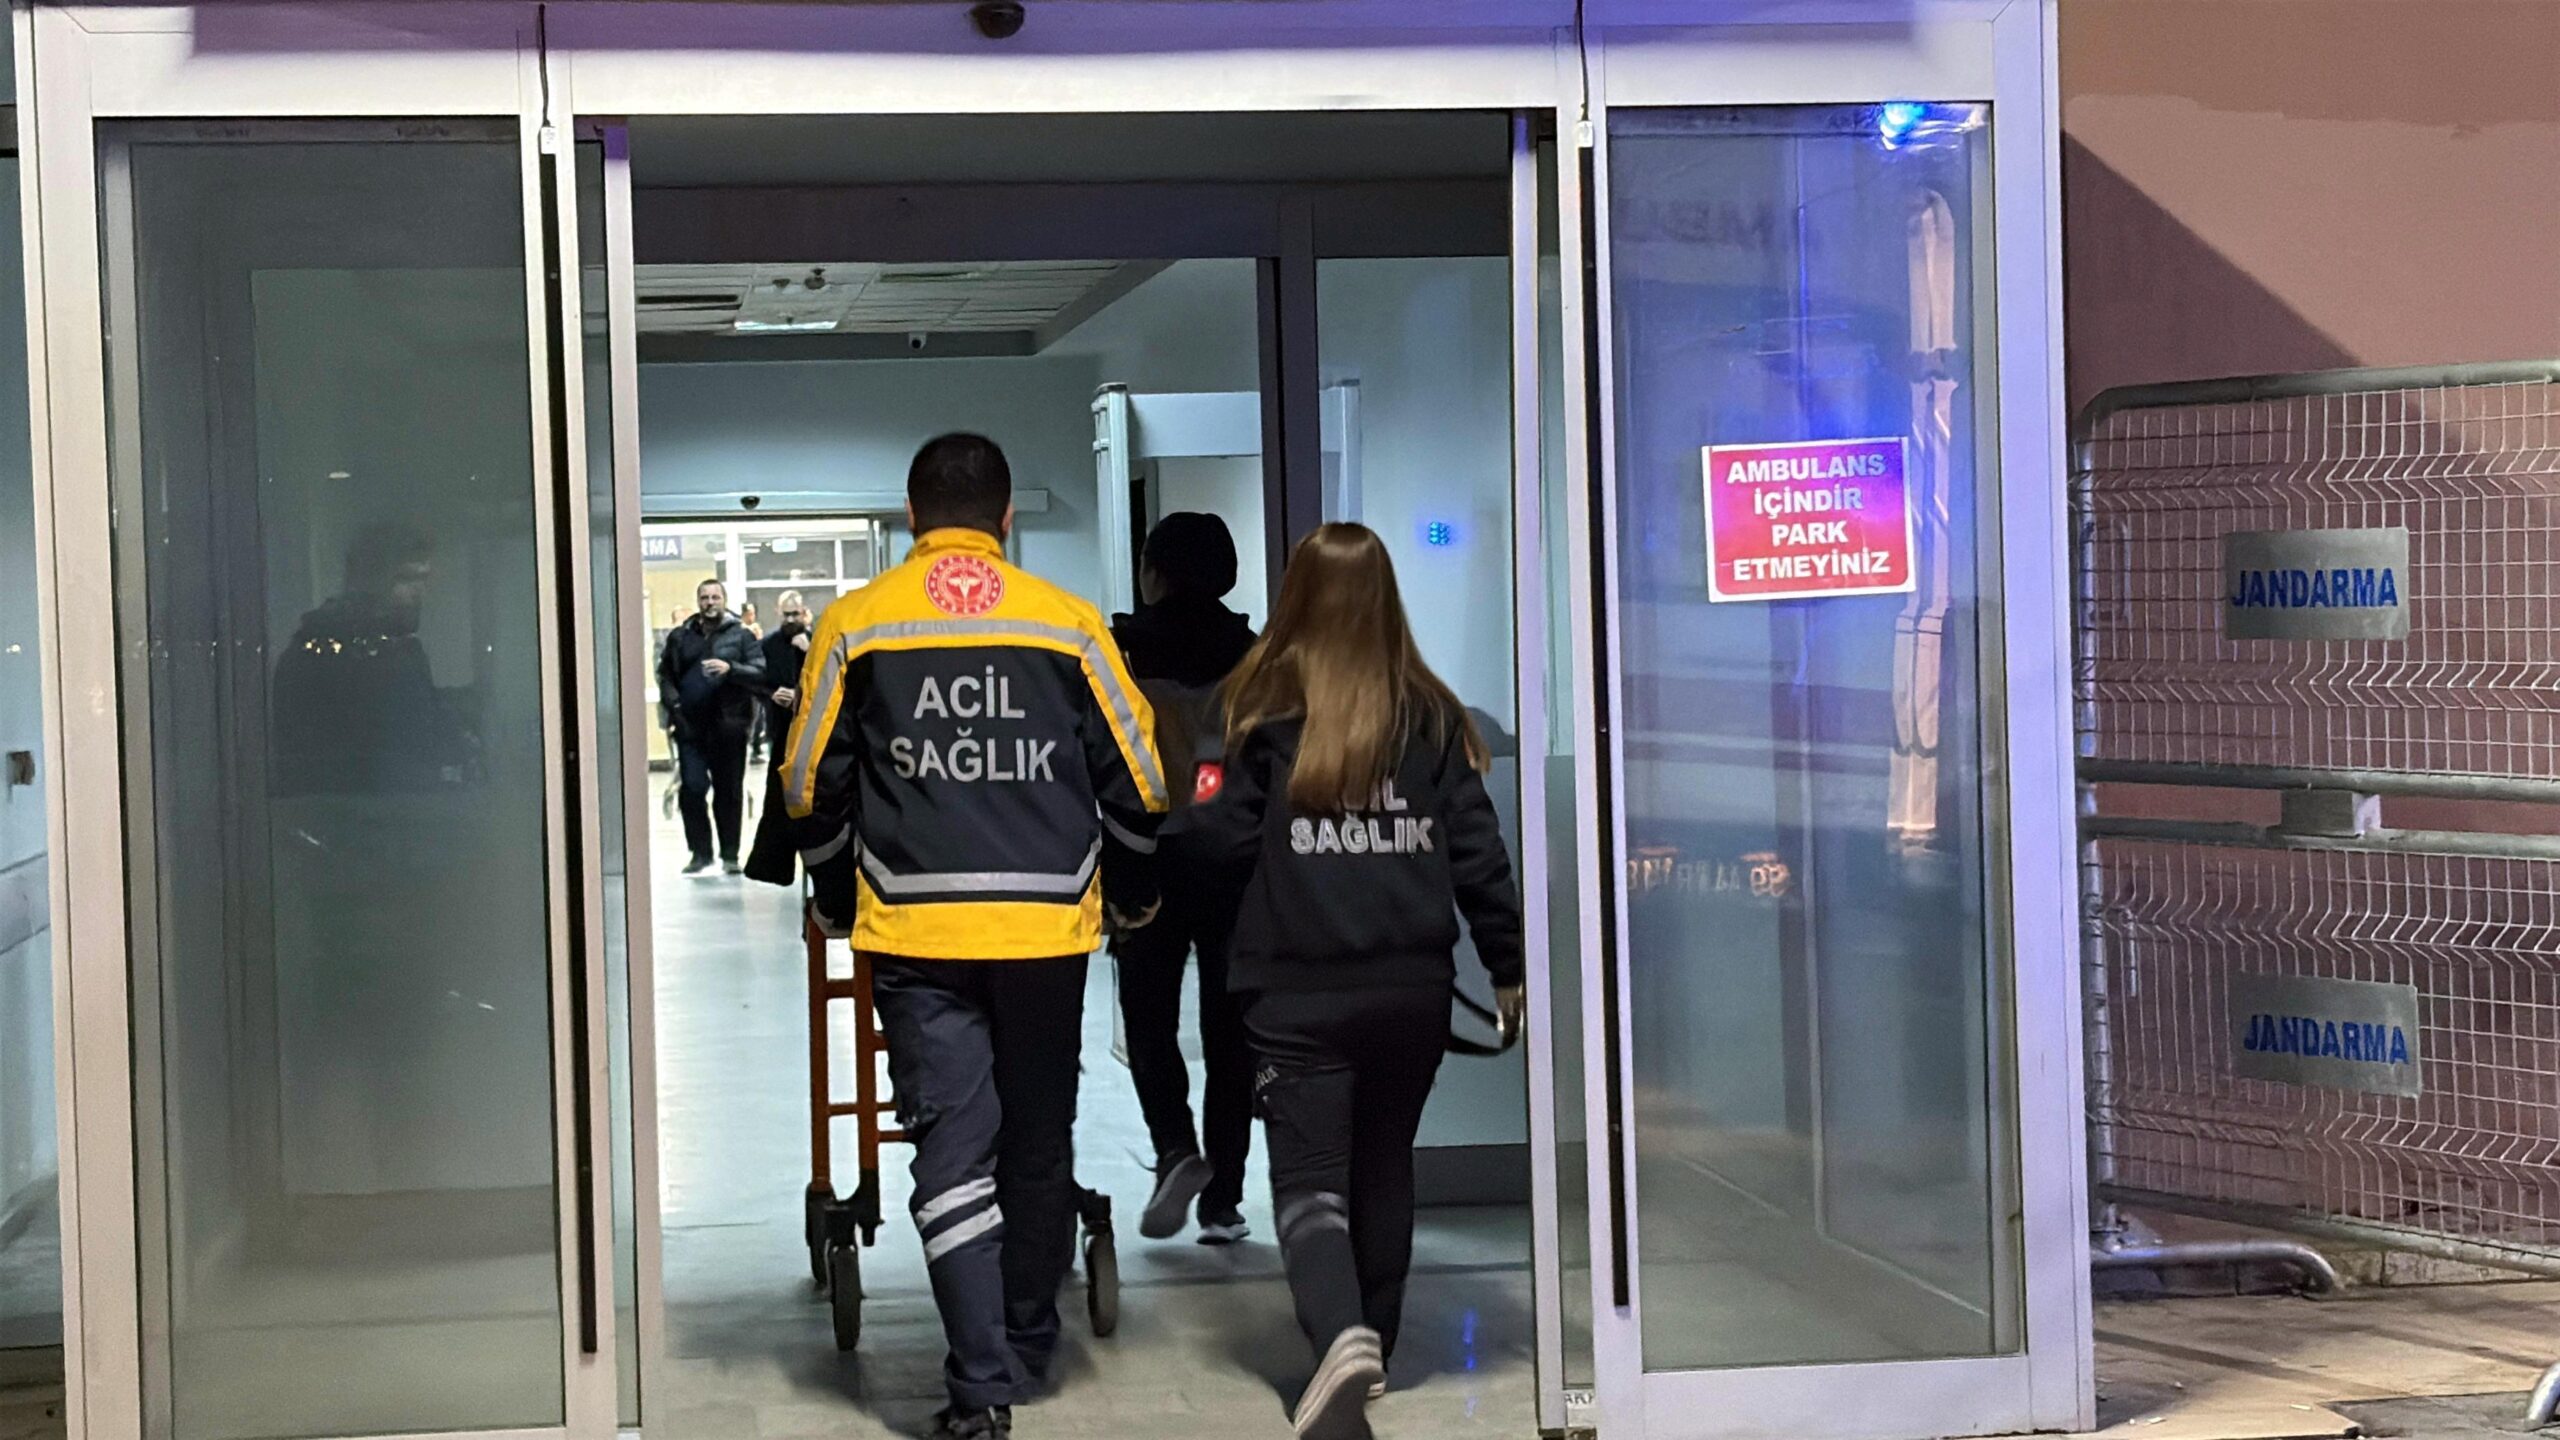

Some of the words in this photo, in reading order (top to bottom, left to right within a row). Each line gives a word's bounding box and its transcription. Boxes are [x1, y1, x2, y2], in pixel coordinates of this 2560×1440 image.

[1726, 454, 1887, 484] AMBULANS
[1754, 484, 1864, 519] İÇİNDİR
[1771, 521, 1849, 547] PARK
[1733, 547, 1891, 581] ETMEYİNİZ
[2232, 567, 2399, 609] JANDARMA
[913, 665, 1027, 719] ACİL
[889, 726, 1058, 782] SAĞLIK
[2243, 1014, 2409, 1065] JANDARMA
